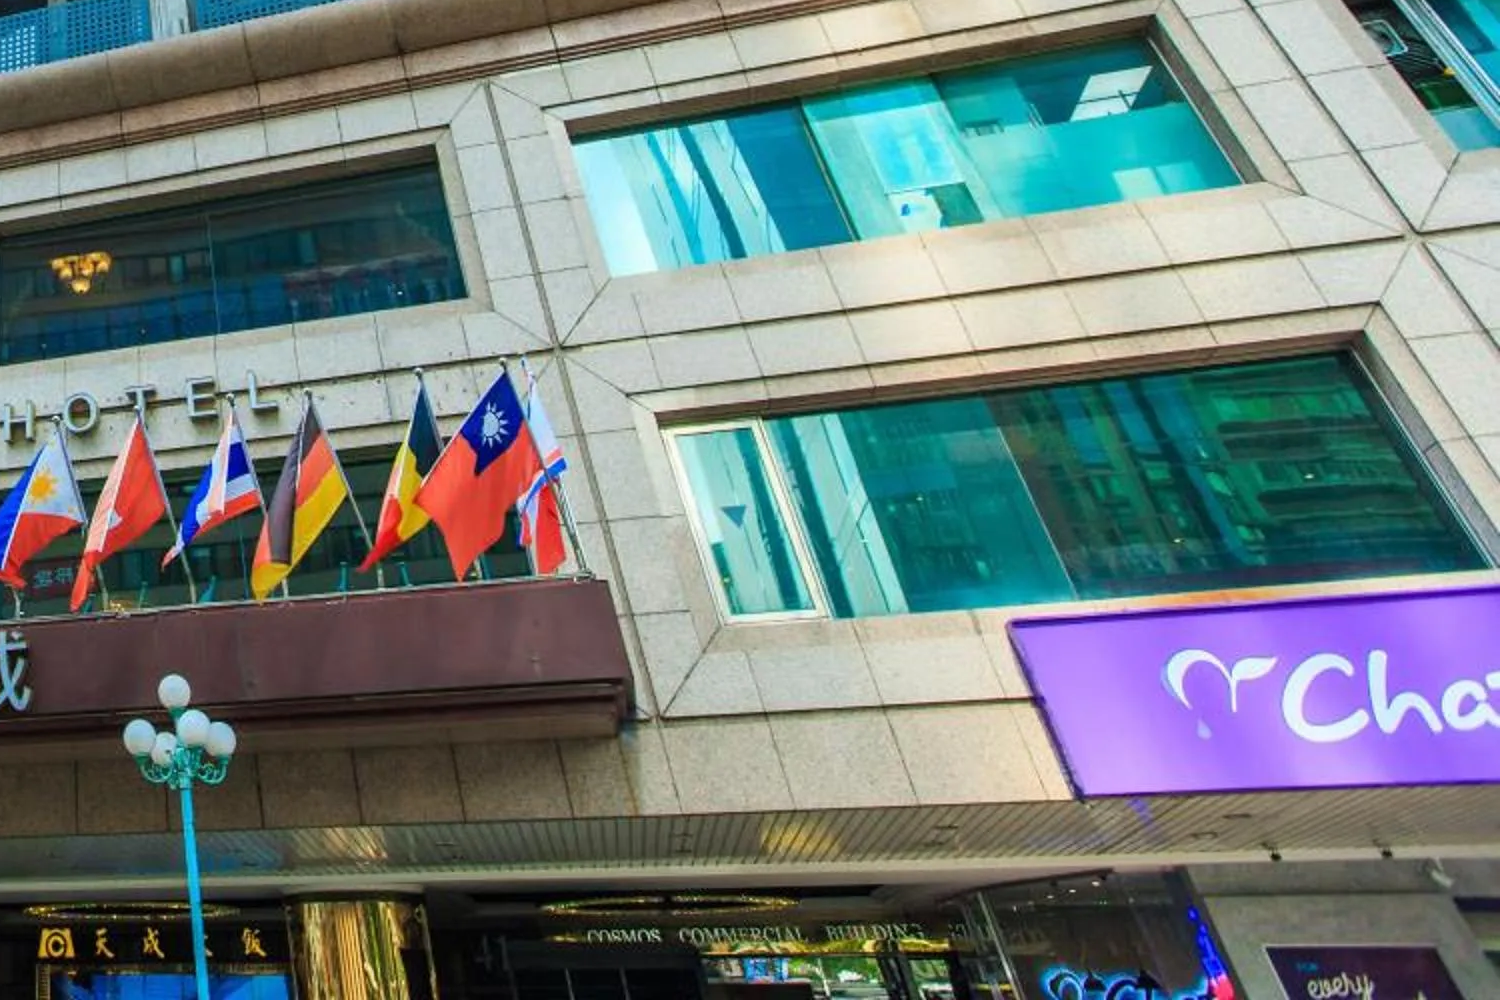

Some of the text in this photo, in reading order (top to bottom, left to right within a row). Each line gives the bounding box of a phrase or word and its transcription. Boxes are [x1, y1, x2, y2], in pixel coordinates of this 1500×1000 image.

[3, 369, 280, 445] HOTEL
[1281, 649, 1500, 743] Cha
[586, 922, 925, 946] COSMOS COMMERCIAL BUILDING
